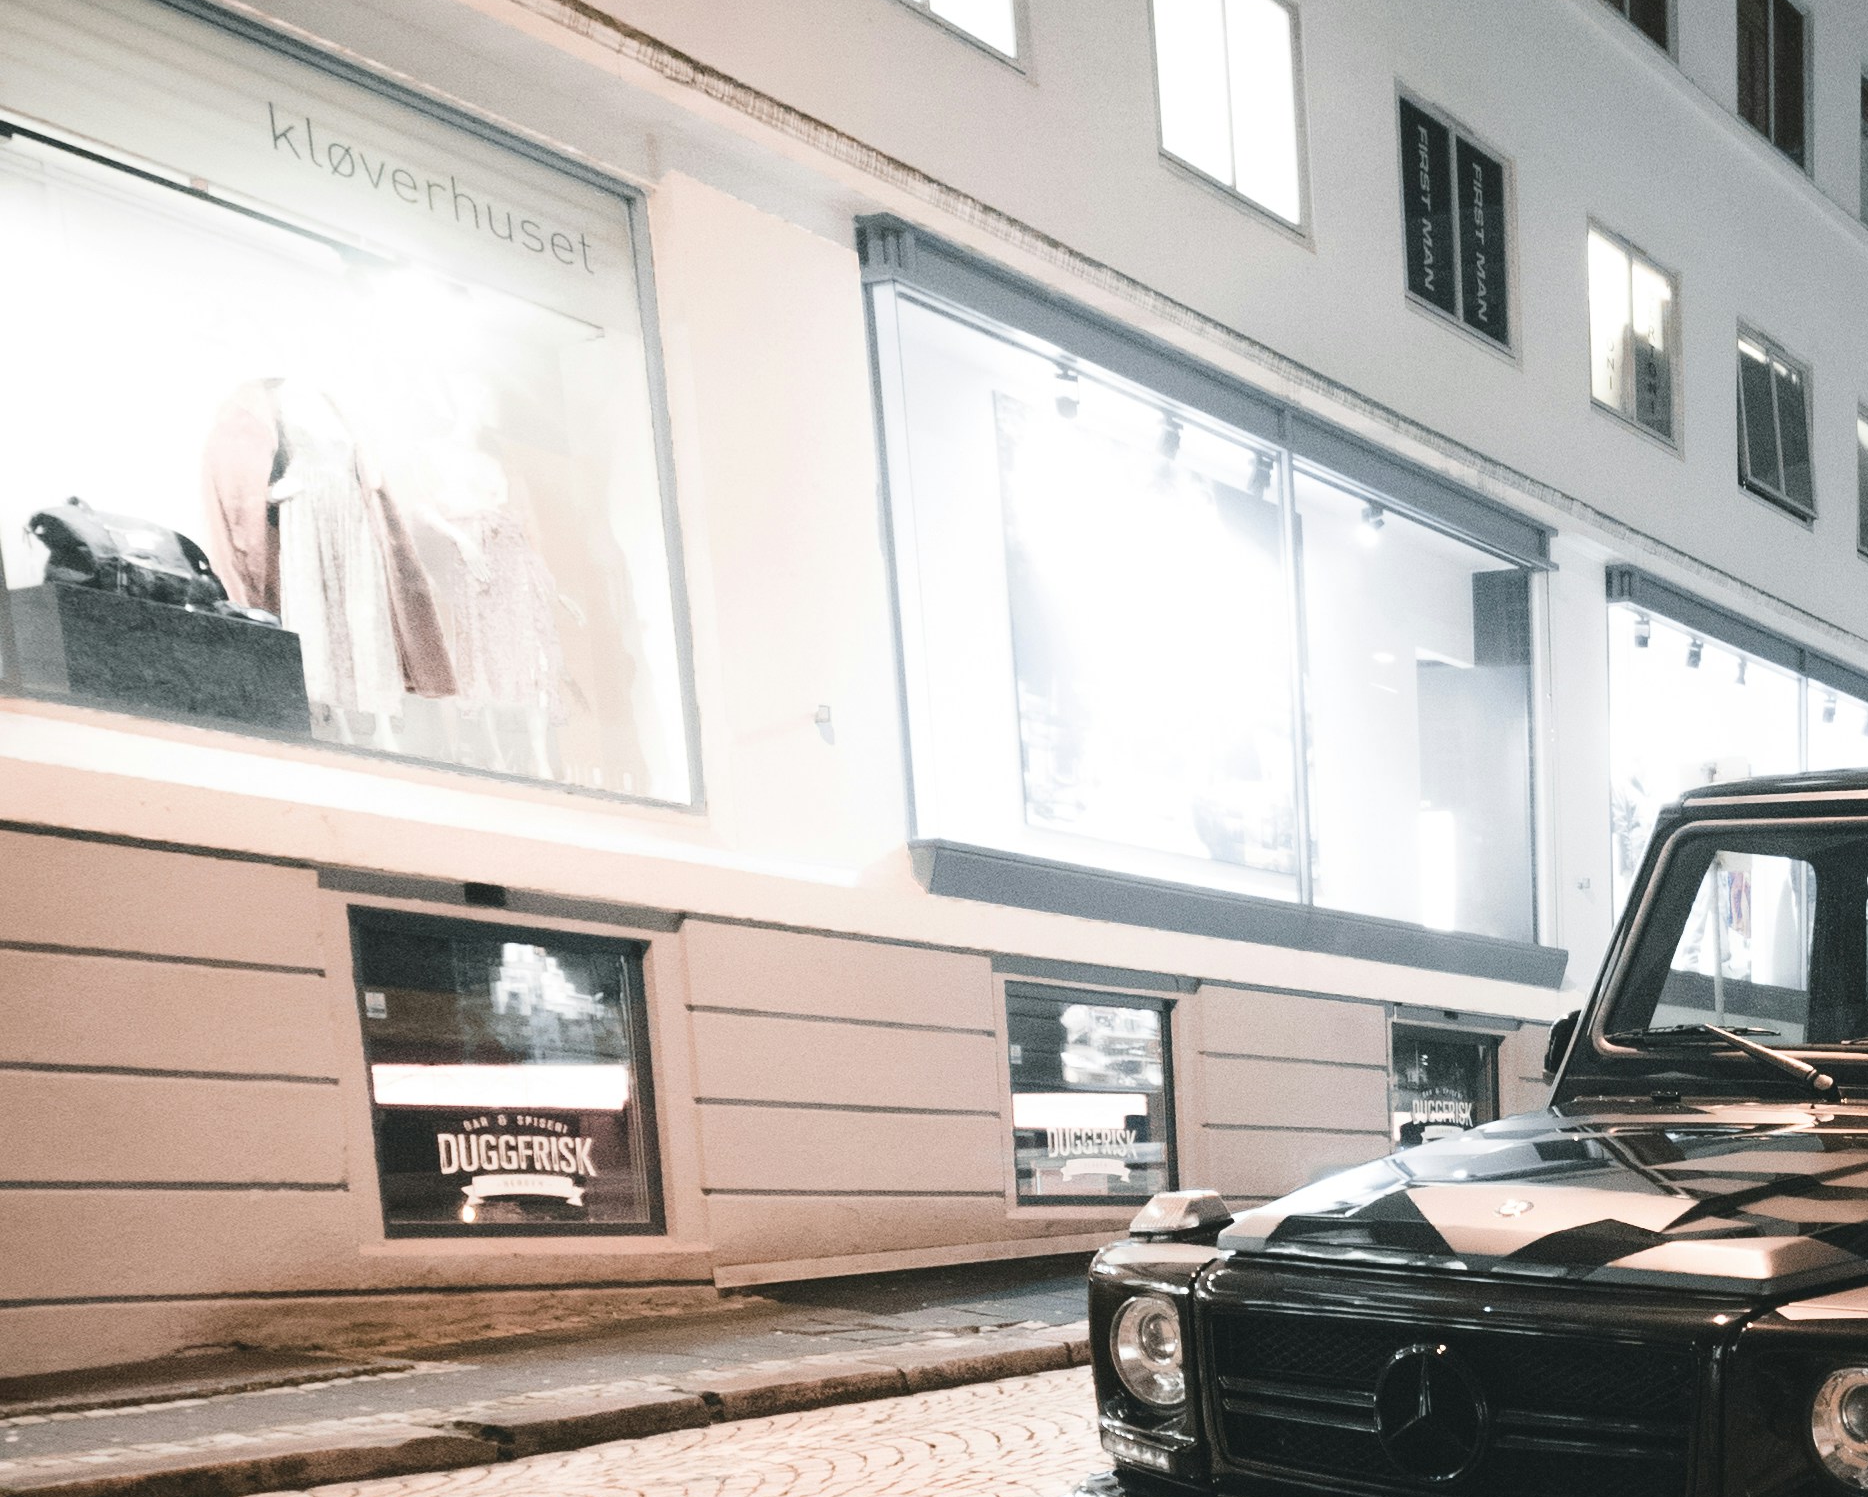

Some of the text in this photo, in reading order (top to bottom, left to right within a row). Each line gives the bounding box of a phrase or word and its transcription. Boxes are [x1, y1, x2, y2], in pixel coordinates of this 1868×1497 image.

[268, 100, 595, 275] kløverhuset
[1417, 124, 1435, 292] FIRST MAN
[1472, 162, 1488, 322] FIRST MAN
[437, 1133, 598, 1177] DUGGFRISK
[1046, 1127, 1138, 1160] DUGGFRISK
